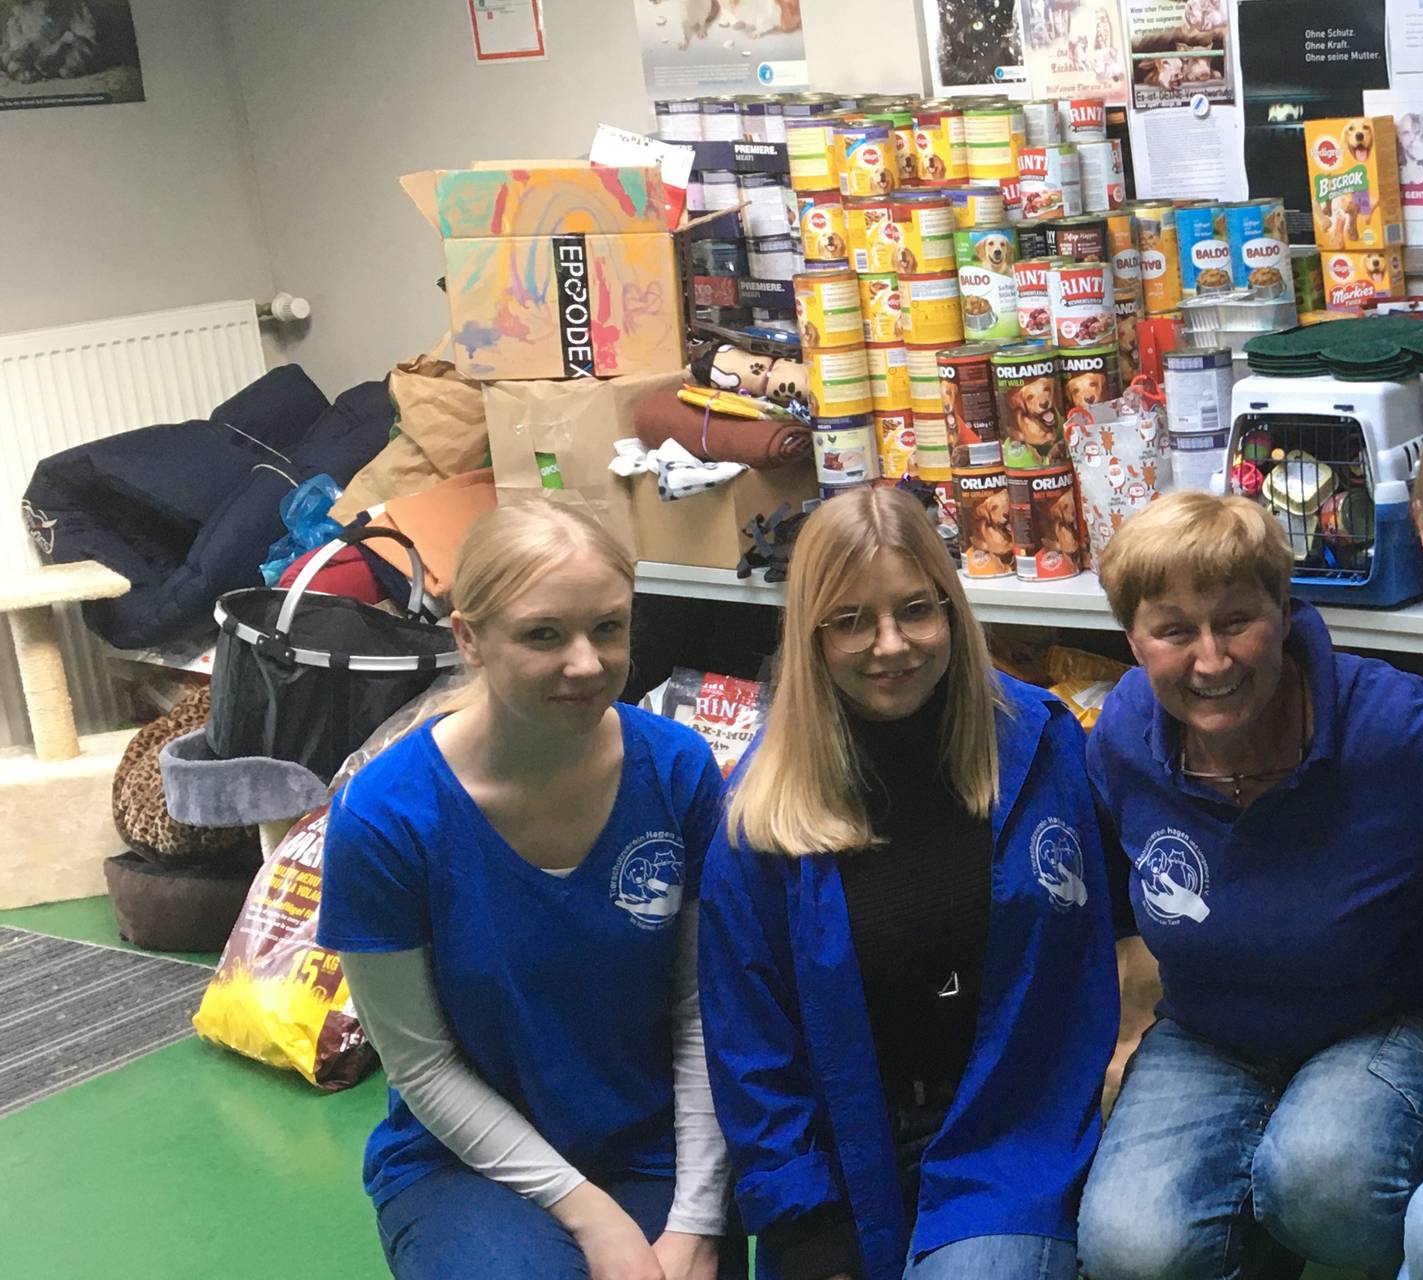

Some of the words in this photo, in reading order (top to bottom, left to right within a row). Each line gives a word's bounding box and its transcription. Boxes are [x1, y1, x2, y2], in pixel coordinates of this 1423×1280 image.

[1305, 30, 1325, 38] Ohne
[1327, 28, 1355, 37] Schutz.
[1305, 41, 1325, 50] Ohne
[1327, 40, 1350, 49] Kraft.
[1305, 53, 1326, 62] Ohne
[1327, 52, 1349, 61] seine
[1195, 247, 1229, 260] BALDO
[1246, 244, 1280, 258] BALDO
[1116, 258, 1139, 269] BALD
[1332, 285, 1374, 304] Markies
[996, 362, 1053, 379] ORLANDO
[1008, 378, 1024, 387] WILD
[1032, 473, 1072, 490] ORLAN
[646, 830, 675, 840] Hagen
[323, 953, 341, 971] KG
